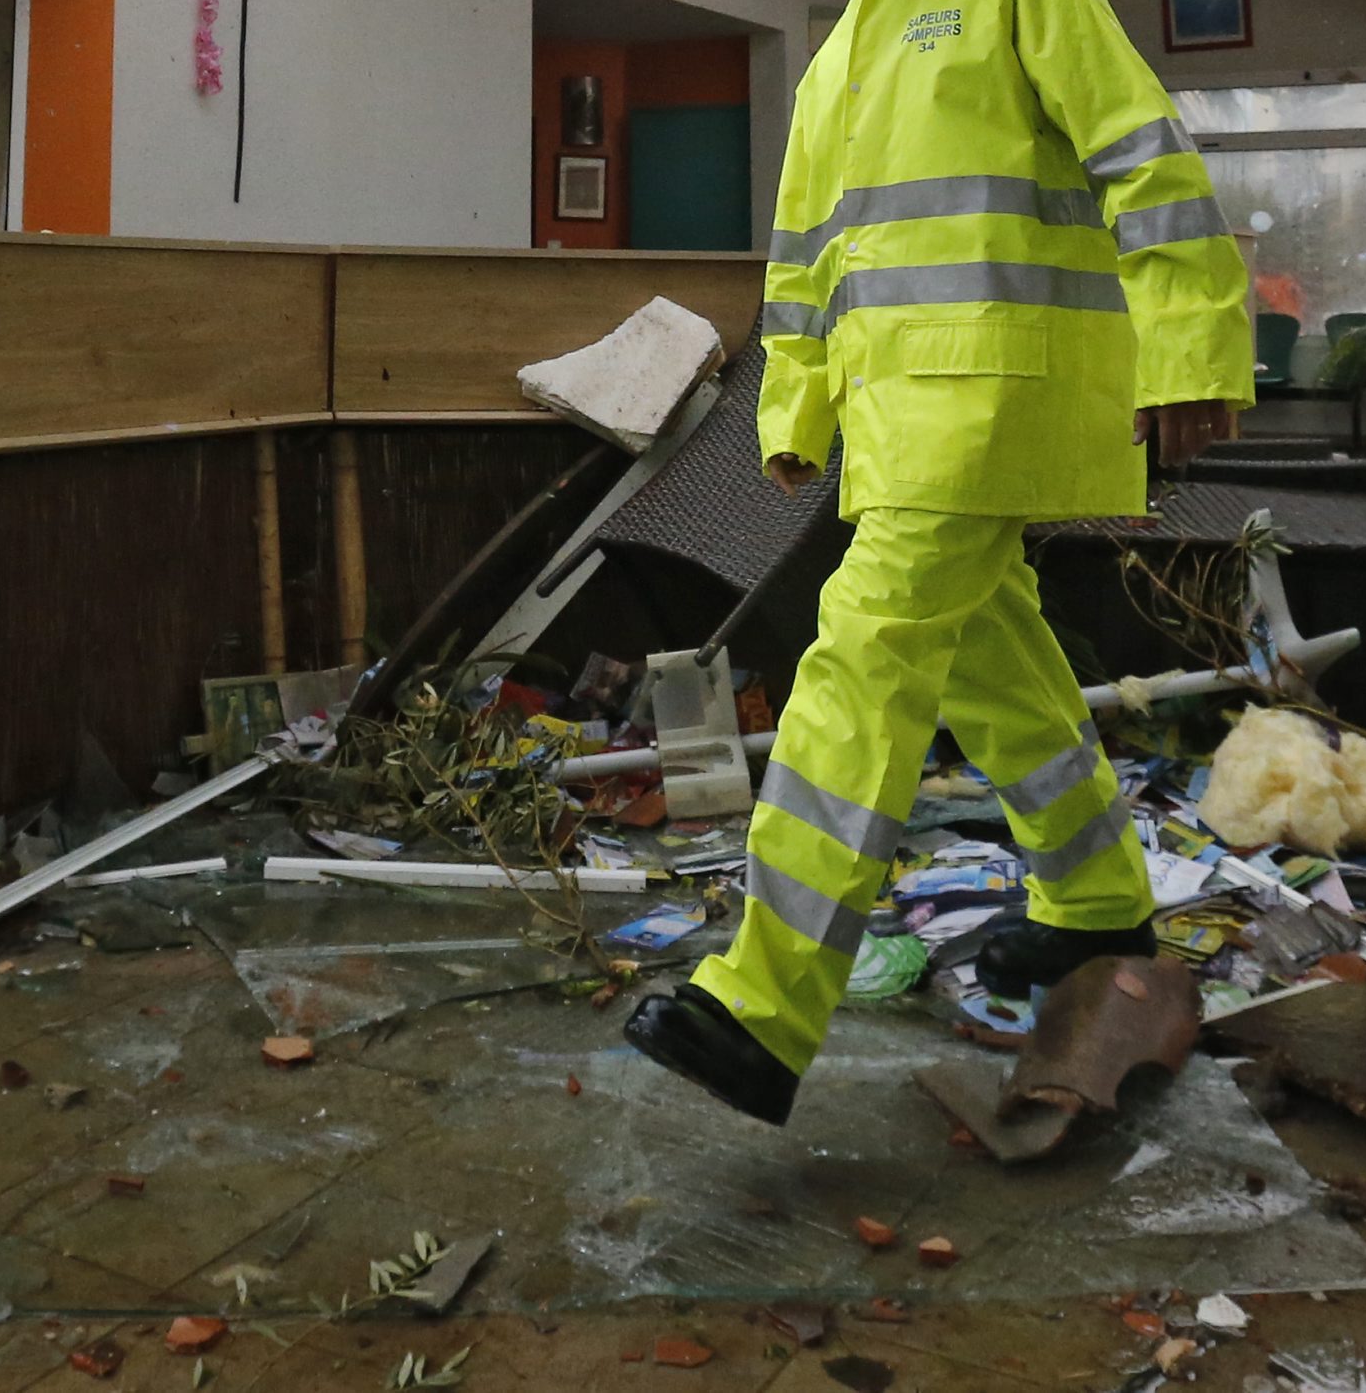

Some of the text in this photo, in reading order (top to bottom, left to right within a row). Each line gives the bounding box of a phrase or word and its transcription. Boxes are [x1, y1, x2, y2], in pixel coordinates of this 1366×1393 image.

[906, 9, 962, 31] SAPEURS
[900, 23, 962, 46] POMPIERS
[918, 41, 936, 53] 34
